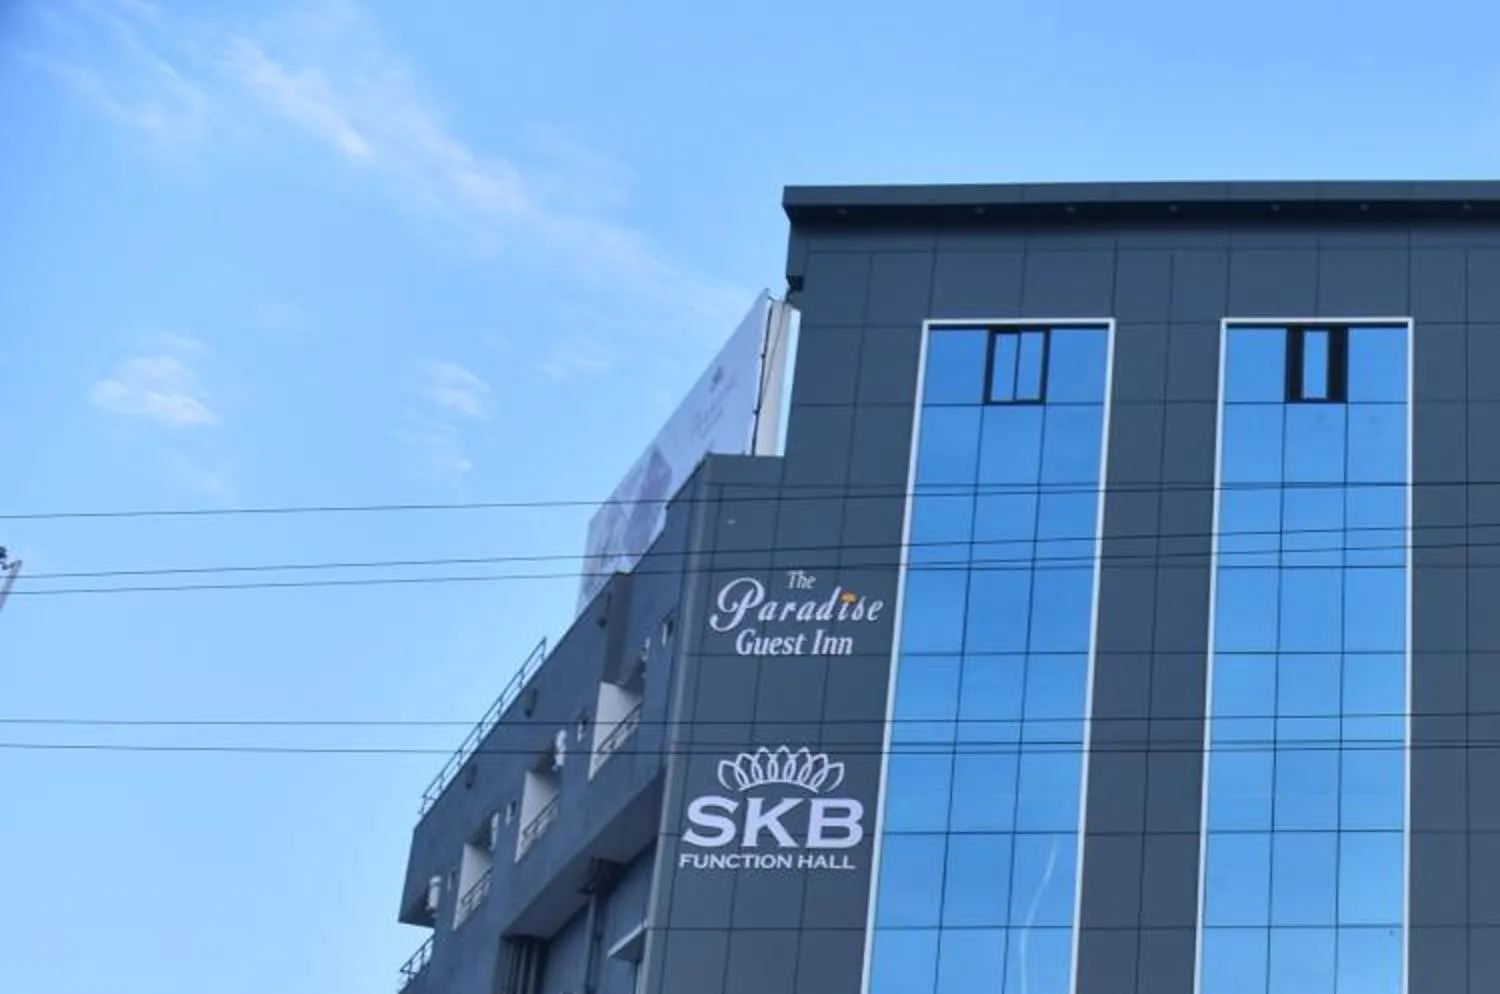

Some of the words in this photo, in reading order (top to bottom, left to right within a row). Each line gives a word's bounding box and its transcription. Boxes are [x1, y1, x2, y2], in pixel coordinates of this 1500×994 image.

[787, 570, 816, 589] The
[709, 577, 883, 632] Paradise
[736, 629, 806, 655] Guest
[812, 629, 853, 655] Inn
[682, 795, 864, 848] SKB
[679, 854, 792, 869] FUNCTION
[797, 855, 856, 870] HALL
